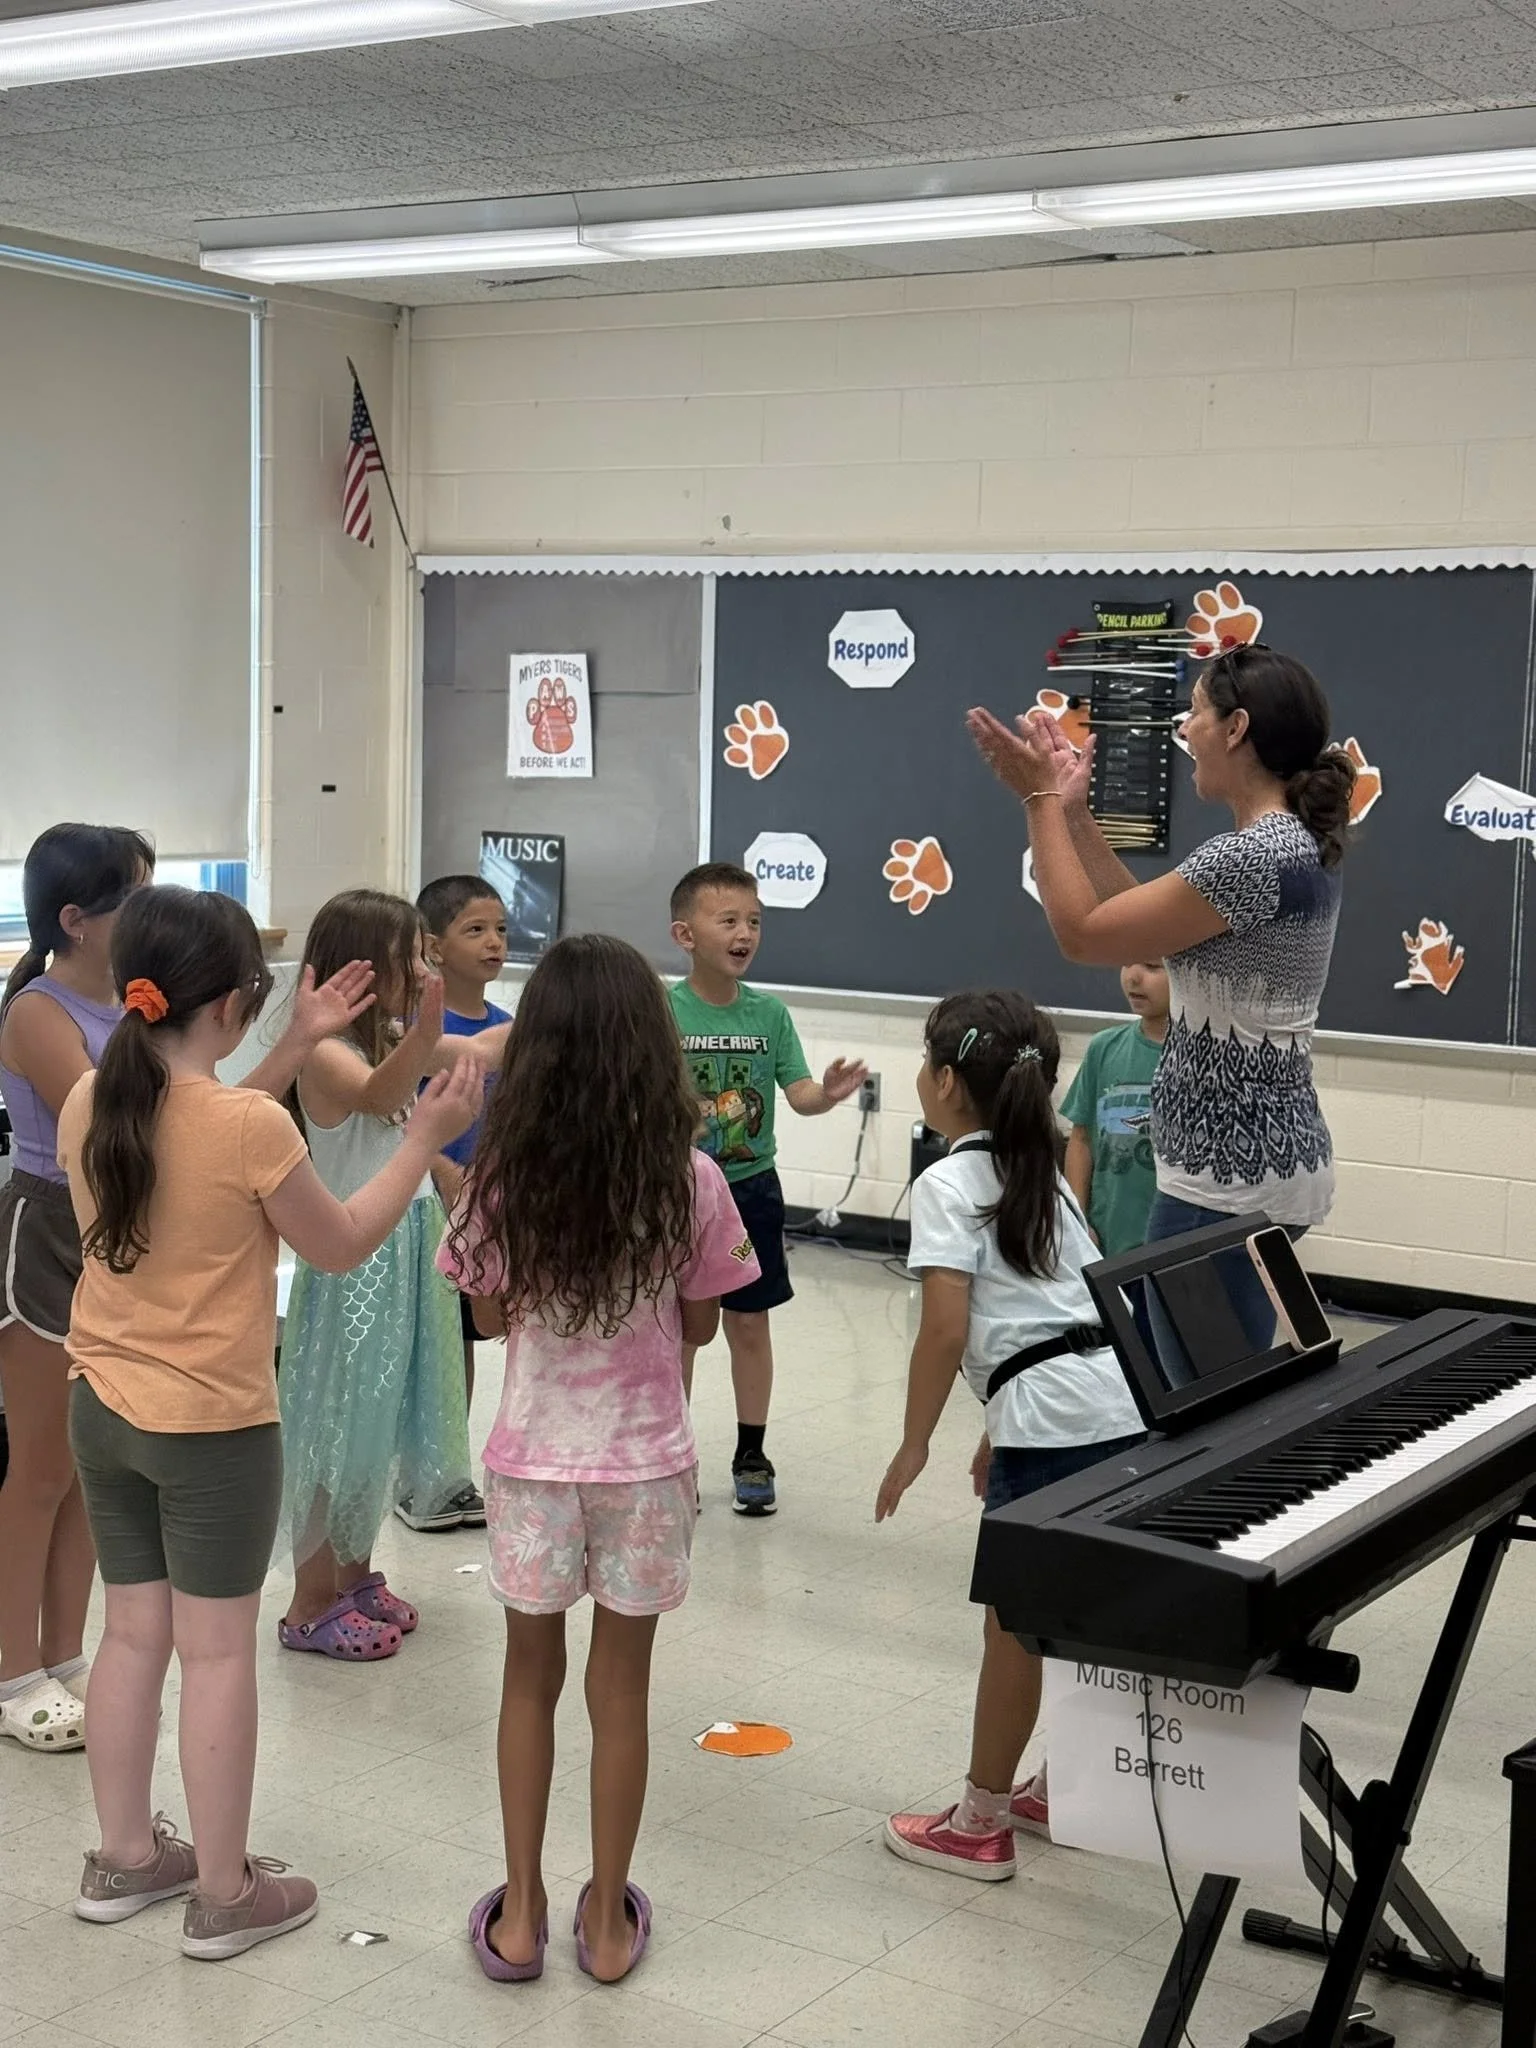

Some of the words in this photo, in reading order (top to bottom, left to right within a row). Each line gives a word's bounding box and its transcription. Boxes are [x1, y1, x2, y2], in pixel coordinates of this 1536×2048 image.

[1097, 613, 1128, 628] PENCIL
[1130, 611, 1167, 628] PARKING
[834, 636, 908, 667] Respond
[519, 659, 552, 684] MYERS
[554, 659, 583, 682] TIGERS
[519, 756, 554, 768] BEFORE
[556, 757, 568, 768] WE
[485, 836, 559, 862] MUSIC
[756, 858, 815, 881] Create
[1076, 1662, 1153, 1697] Music
[1163, 1677, 1245, 1715] Room
[1135, 1711, 1182, 1744] 126
[1115, 1746, 1206, 1790] Barrett
